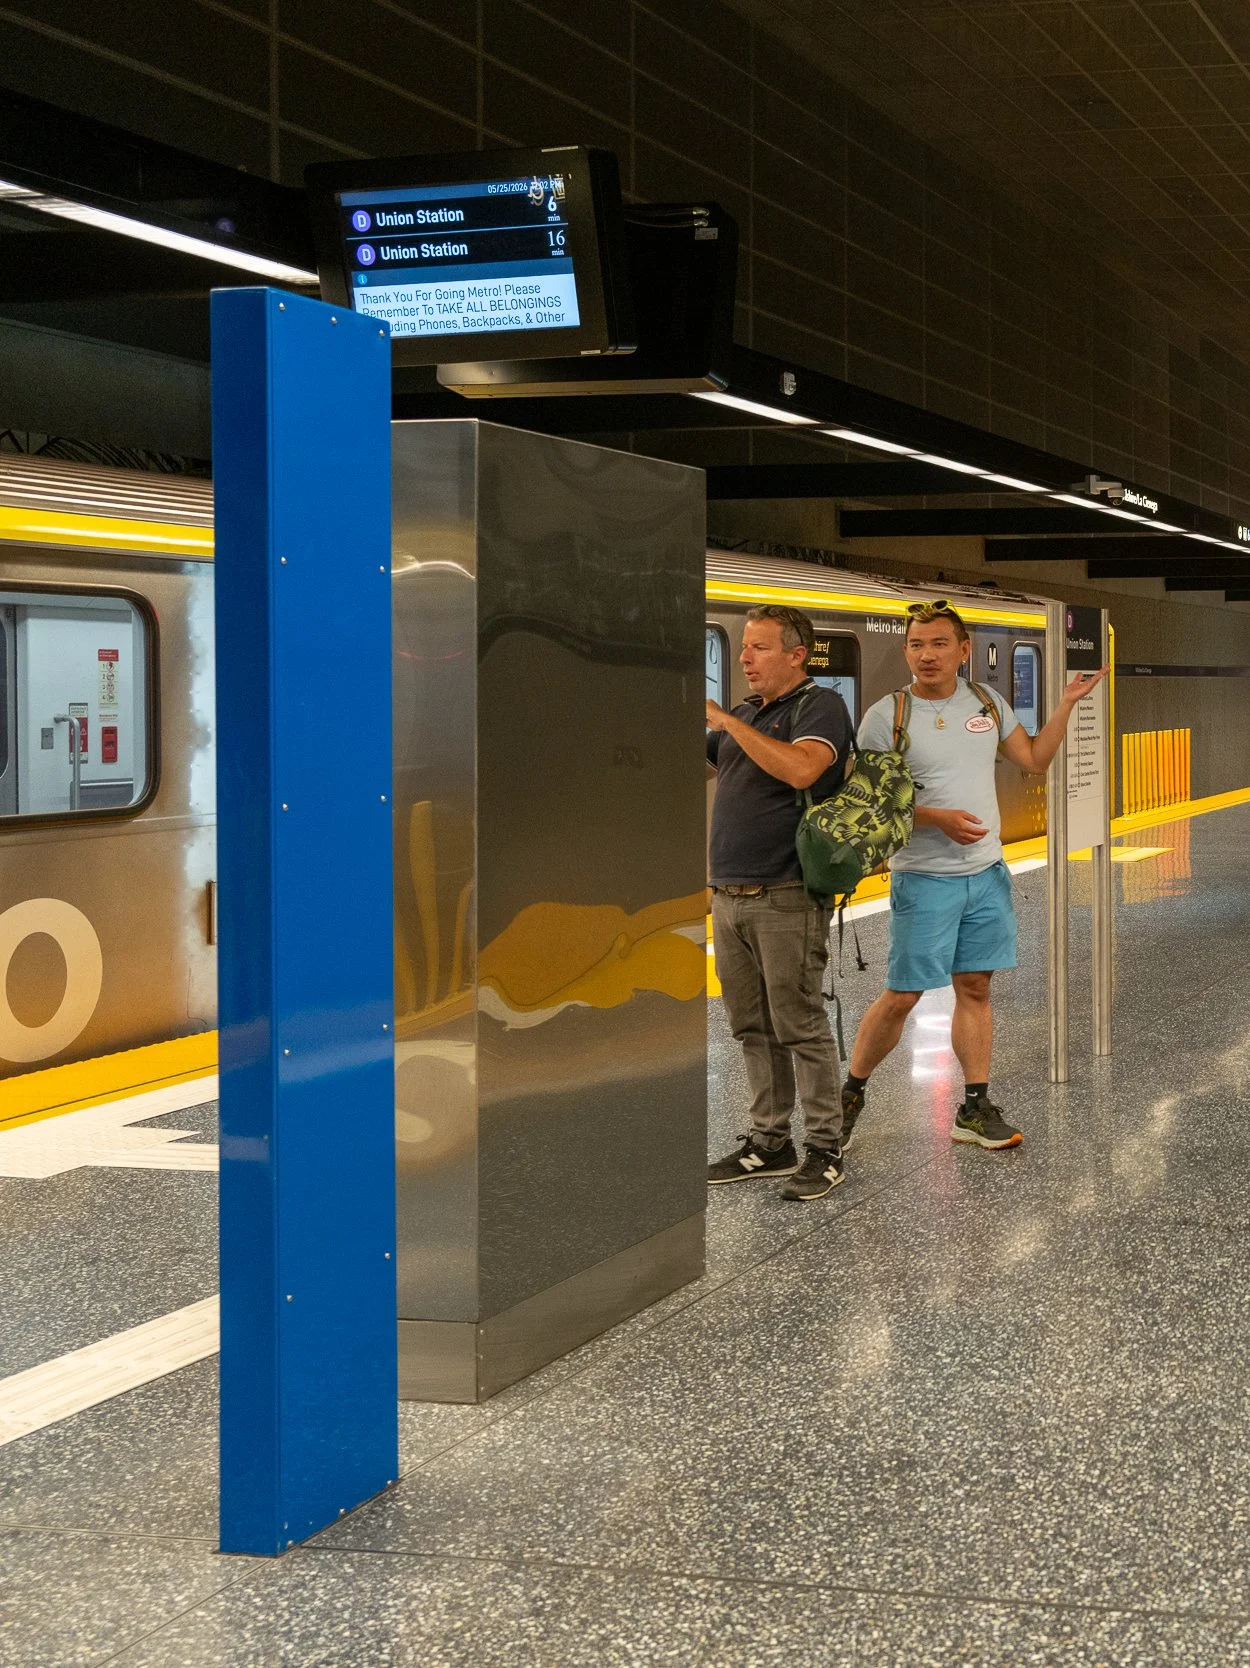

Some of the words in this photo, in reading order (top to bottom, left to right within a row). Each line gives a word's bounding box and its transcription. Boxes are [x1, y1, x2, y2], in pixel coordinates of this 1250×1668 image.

[487, 182, 528, 194] 05/25/2026
[547, 195, 557, 211] 6
[357, 214, 367, 228] D
[375, 211, 414, 227] Union
[416, 208, 464, 224] Station
[548, 214, 561, 222] min
[548, 230, 566, 246] 16
[361, 248, 371, 262] D
[380, 245, 418, 260] Union
[420, 241, 468, 258] Station
[551, 248, 565, 256] min
[360, 292, 392, 305] Thank
[393, 291, 413, 302] You
[416, 289, 432, 301] For
[435, 288, 465, 300] Going
[468, 284, 502, 298] Metro!
[505, 284, 541, 296] Please
[362, 305, 419, 318] Remember
[422, 304, 434, 315] To
[436, 301, 463, 314] TAKE
[466, 300, 487, 313] ALL
[490, 296, 562, 312] BELONGINGS
[419, 318, 461, 331] Phones,
[463, 314, 524, 329] Backpacks,
[525, 312, 533, 324] &
[535, 311, 565, 323] Other
[866, 616, 891, 633] Metro
[813, 641, 830, 654] hire/
[1065, 637, 1079, 650] Union
[1079, 638, 1094, 650] Station
[988, 647, 997, 666] M
